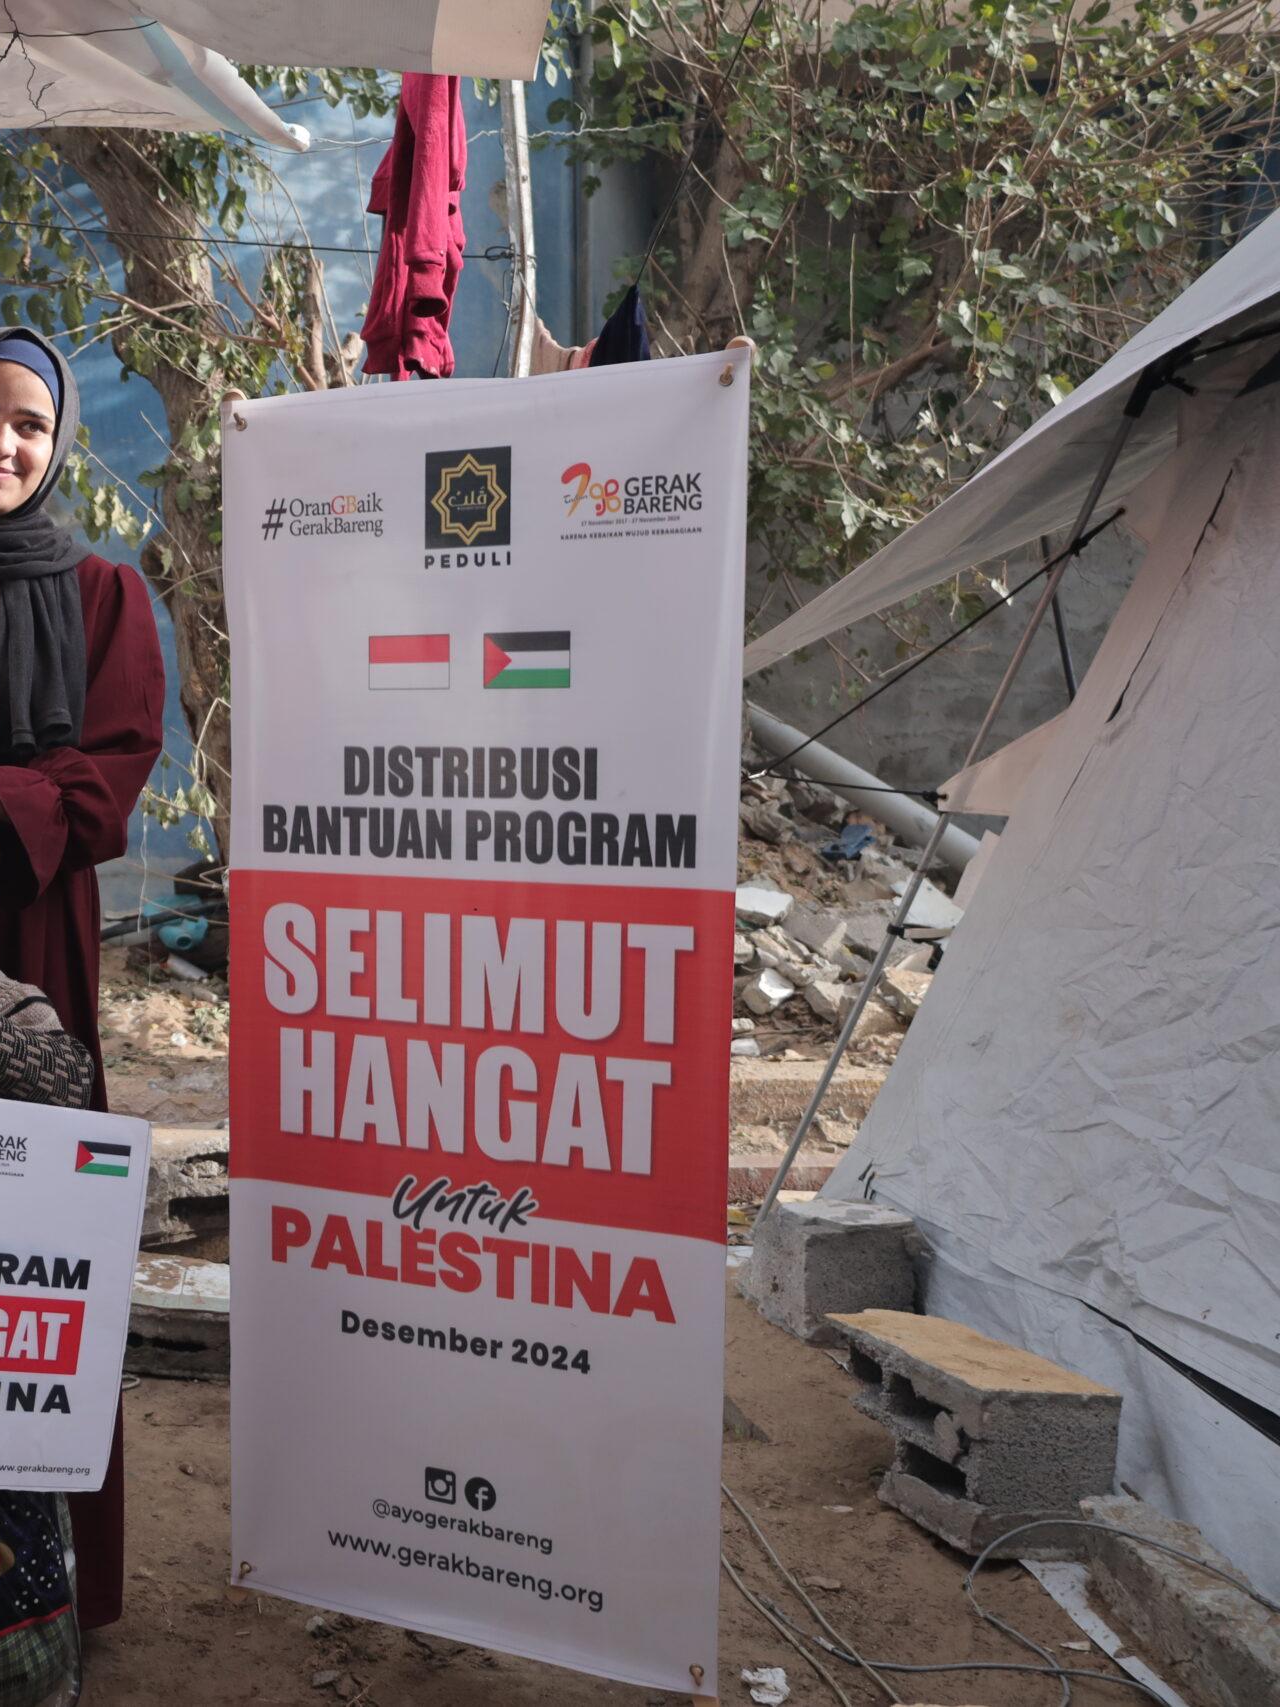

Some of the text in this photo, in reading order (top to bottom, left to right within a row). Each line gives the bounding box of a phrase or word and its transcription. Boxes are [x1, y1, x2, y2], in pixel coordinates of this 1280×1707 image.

[623, 494, 702, 514] BARENG
[624, 472, 701, 497] GERAK
[289, 518, 383, 536] GerakBareng
[424, 551, 511, 569] PEDULI
[344, 746, 598, 801] DISTRIBUSI
[263, 804, 697, 869] BANTUAN PROGRAM
[263, 902, 694, 1044] SELIMUT
[279, 1027, 672, 1176] HANGAT
[393, 1177, 537, 1232] Untuk
[271, 1205, 676, 1324] PALESTINA
[341, 1310, 590, 1374] Desember 2024
[373, 1499, 552, 1554] @ayogerakbareng
[328, 1530, 603, 1612] www.gerakbareng.org
